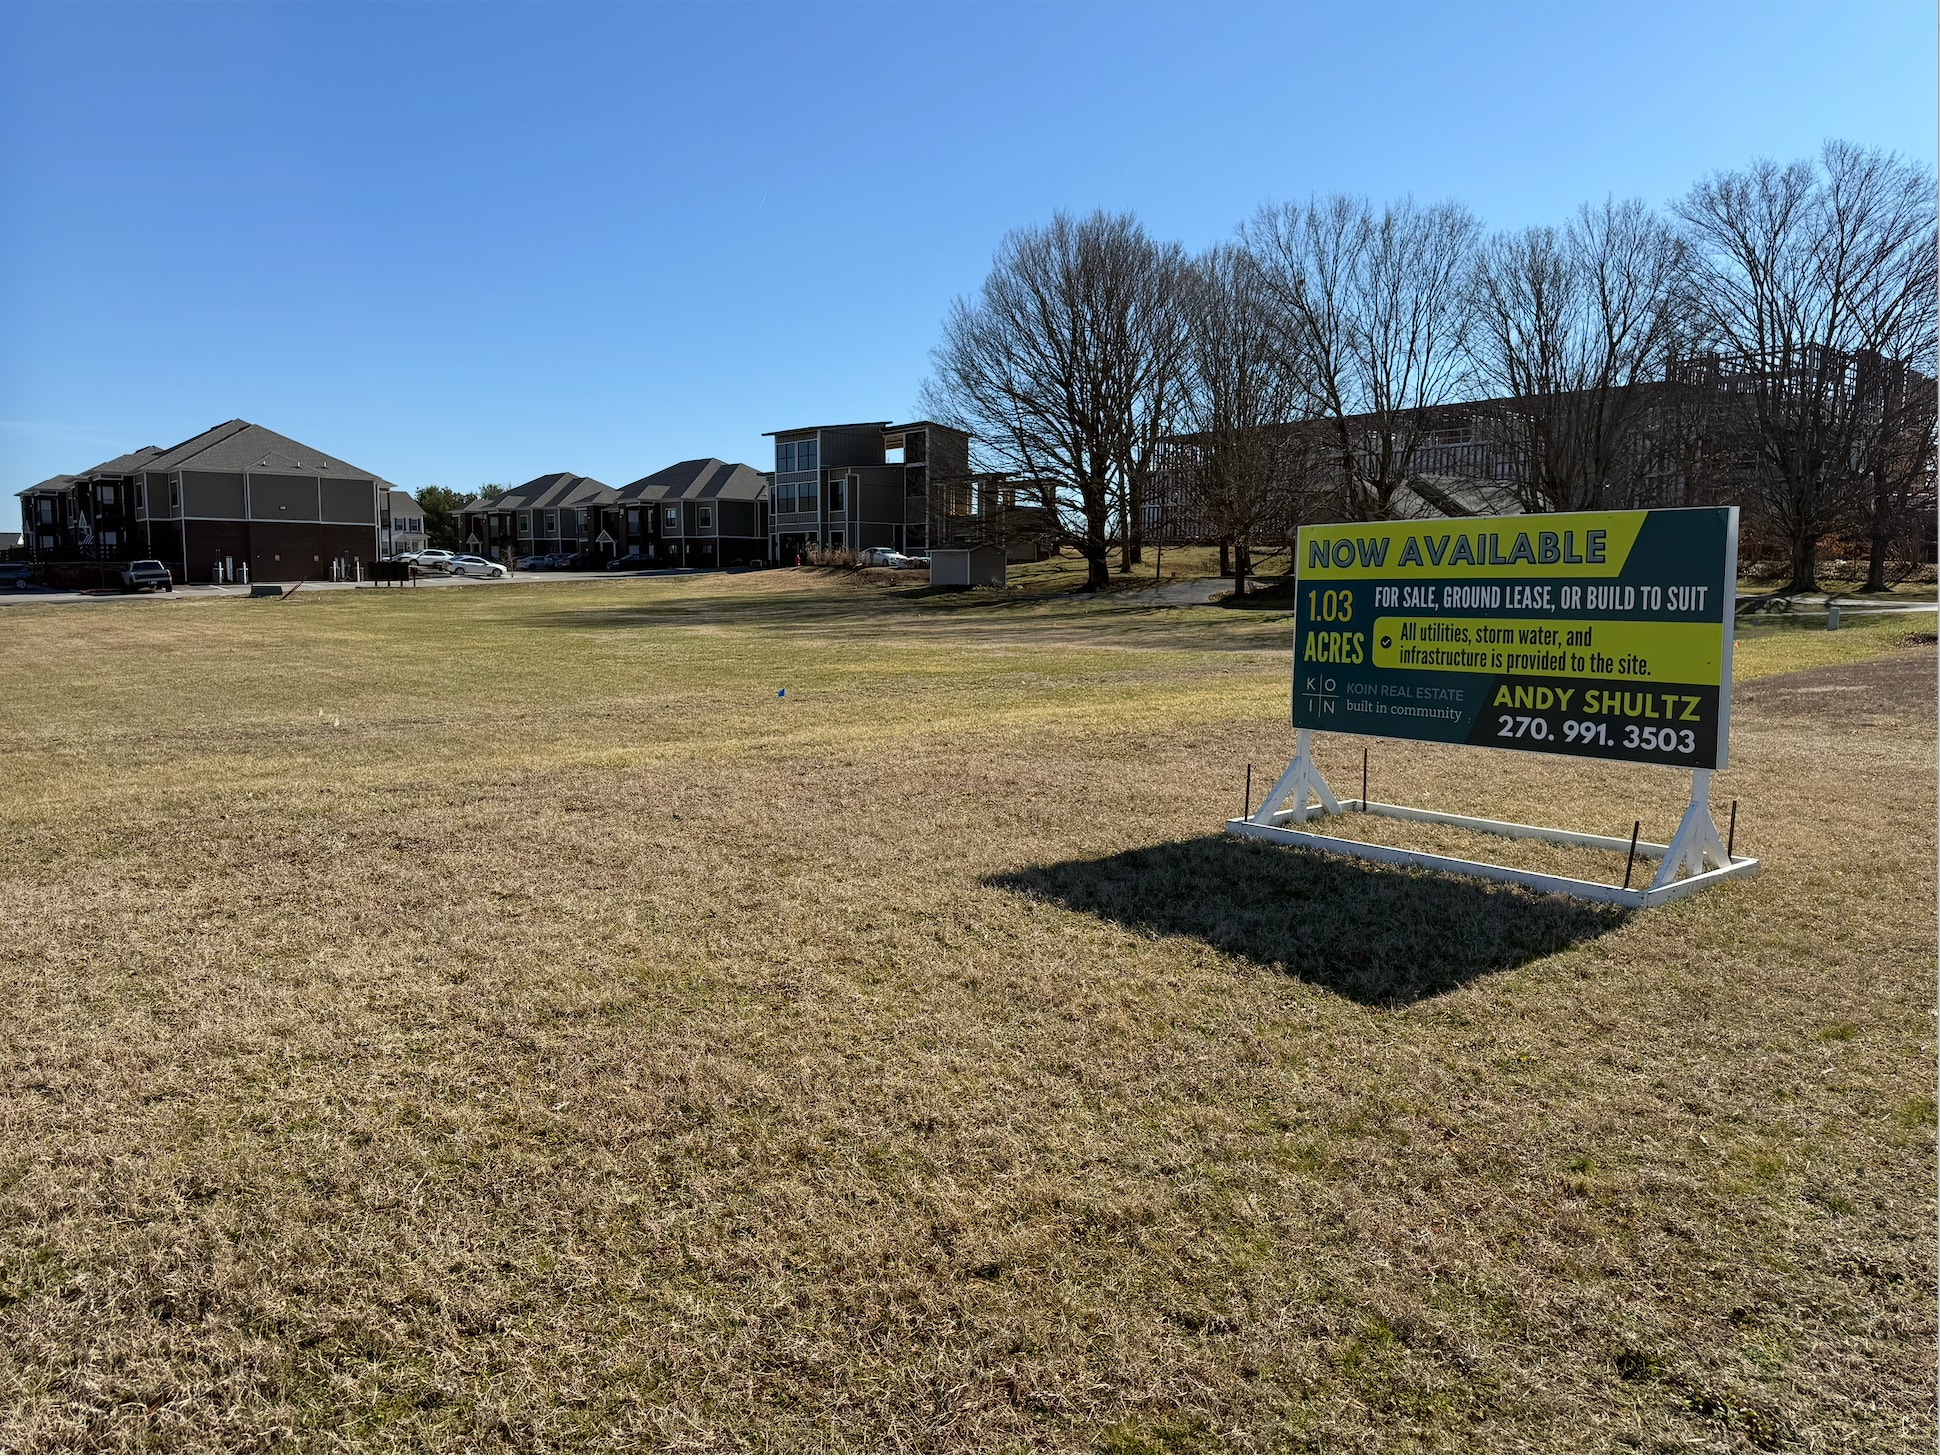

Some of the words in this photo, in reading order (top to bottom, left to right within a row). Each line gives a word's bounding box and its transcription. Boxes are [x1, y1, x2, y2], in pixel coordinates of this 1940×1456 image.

[1308, 537, 1390, 568] NOW
[1398, 529, 1607, 567] AVAILABLE
[1308, 589, 1354, 622] 1.03
[1374, 586, 1399, 608] FOR
[1402, 586, 1440, 611] SALE,
[1443, 586, 1501, 609] GROUND
[1505, 585, 1556, 613] LEASE,
[1560, 586, 1582, 610] OR
[1586, 586, 1636, 611] BUILD
[1640, 586, 1662, 611] TO
[1667, 586, 1709, 612] SUIT
[1303, 630, 1365, 665] ACRES
[1400, 622, 1417, 641] All
[1420, 622, 1472, 646] utilities,
[1475, 625, 1514, 645] storm
[1518, 626, 1562, 649] water,
[1566, 625, 1593, 647] and
[1399, 645, 1487, 668] infrastructure
[1491, 648, 1503, 669] is
[1506, 650, 1567, 673] provided
[1570, 654, 1585, 672] to
[1589, 652, 1614, 674] the
[1617, 653, 1651, 676] site.
[1346, 682, 1378, 696] KOIN
[1380, 684, 1413, 699] REAL
[1416, 687, 1464, 702] ESTATE
[1492, 684, 1576, 712] ANDY
[1582, 689, 1702, 722] SHULTZ
[1346, 699, 1374, 713] built
[1376, 701, 1388, 714] in
[1390, 704, 1463, 723] community
[1497, 714, 1555, 742] 270.
[1562, 719, 1615, 747] 991.
[1622, 724, 1696, 754] 3503
